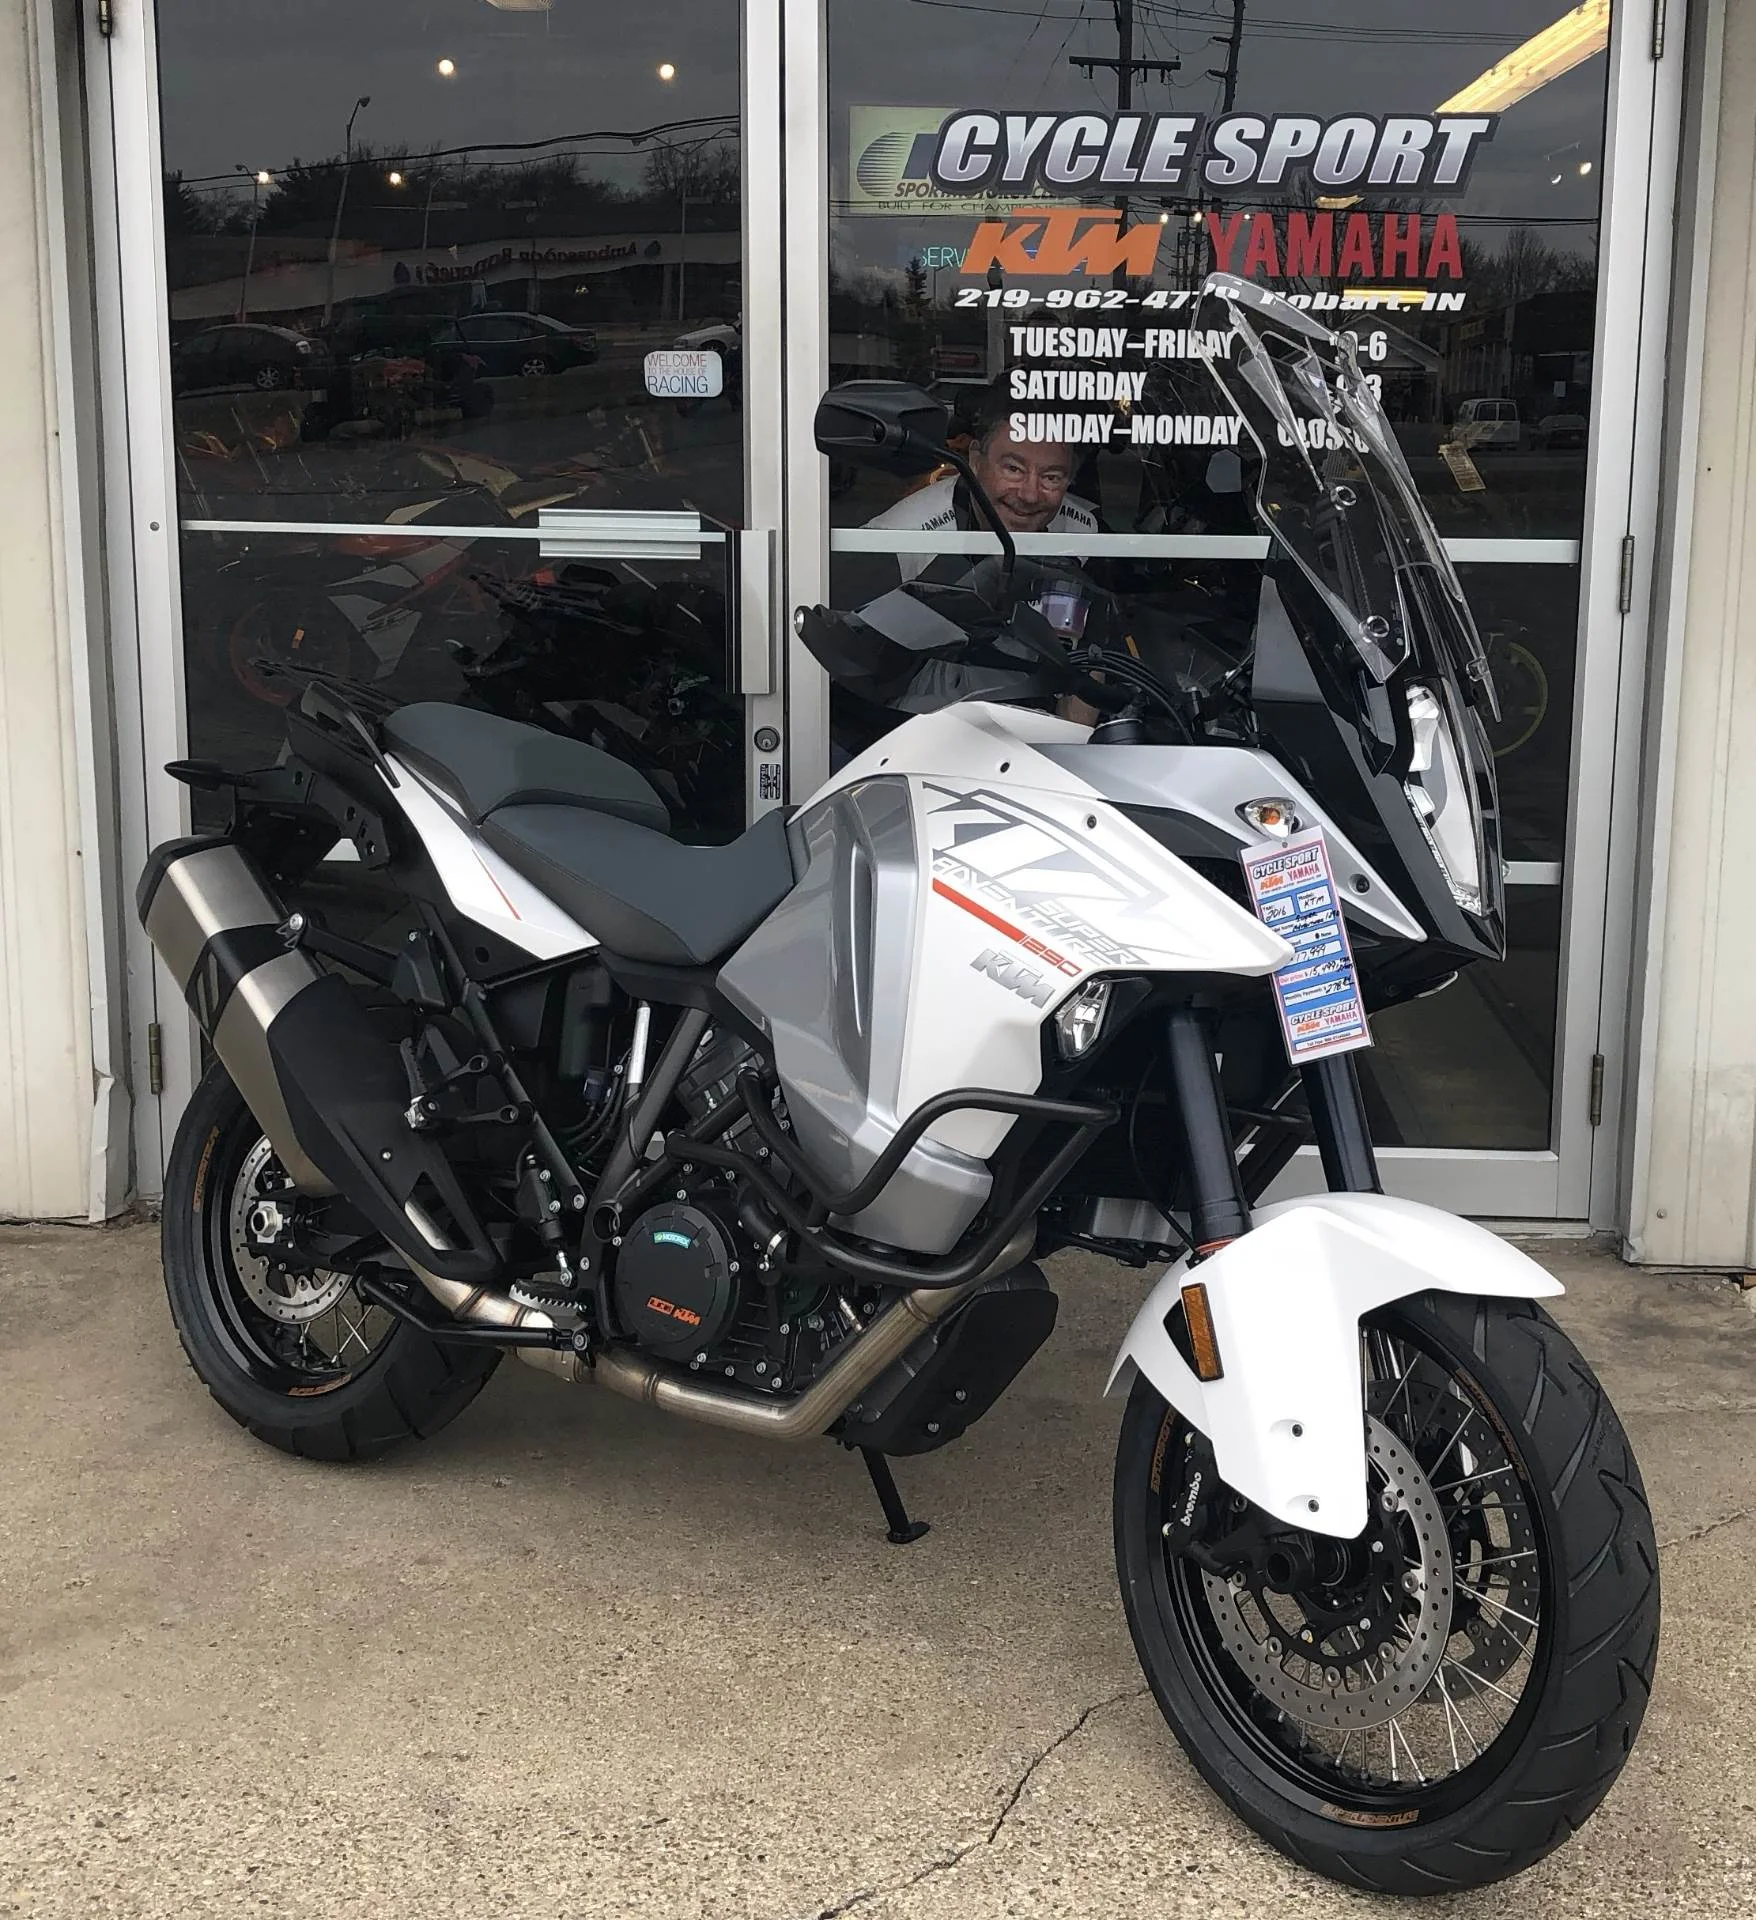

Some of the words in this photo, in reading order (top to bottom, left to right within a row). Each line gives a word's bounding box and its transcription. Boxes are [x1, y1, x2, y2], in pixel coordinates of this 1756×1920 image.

[934, 112, 1198, 187] CYCLE
[1203, 115, 1492, 188] SPORT
[960, 208, 1165, 276] KTM
[1205, 212, 1463, 279] YAMAHA
[1420, 292, 1466, 312] IN
[646, 353, 707, 367] WELCOME
[659, 367, 671, 375] THE
[647, 375, 709, 394] RACING
[1009, 370, 1146, 401] SATURDAY
[1058, 504, 1093, 528] AMAHA
[1252, 858, 1285, 880] CYCLE
[1284, 848, 1319, 870] SPORT
[1287, 863, 1320, 882] YAMAHA
[1265, 905, 1287, 921] 2016
[1018, 936, 1083, 978] 1290
[969, 947, 1057, 1009] KTM
[1290, 1010, 1323, 1026] CYCLE
[1322, 1000, 1357, 1018] SPORT
[1323, 1010, 1358, 1026] YAMAHA
[1180, 1471, 1202, 1527] brembo
